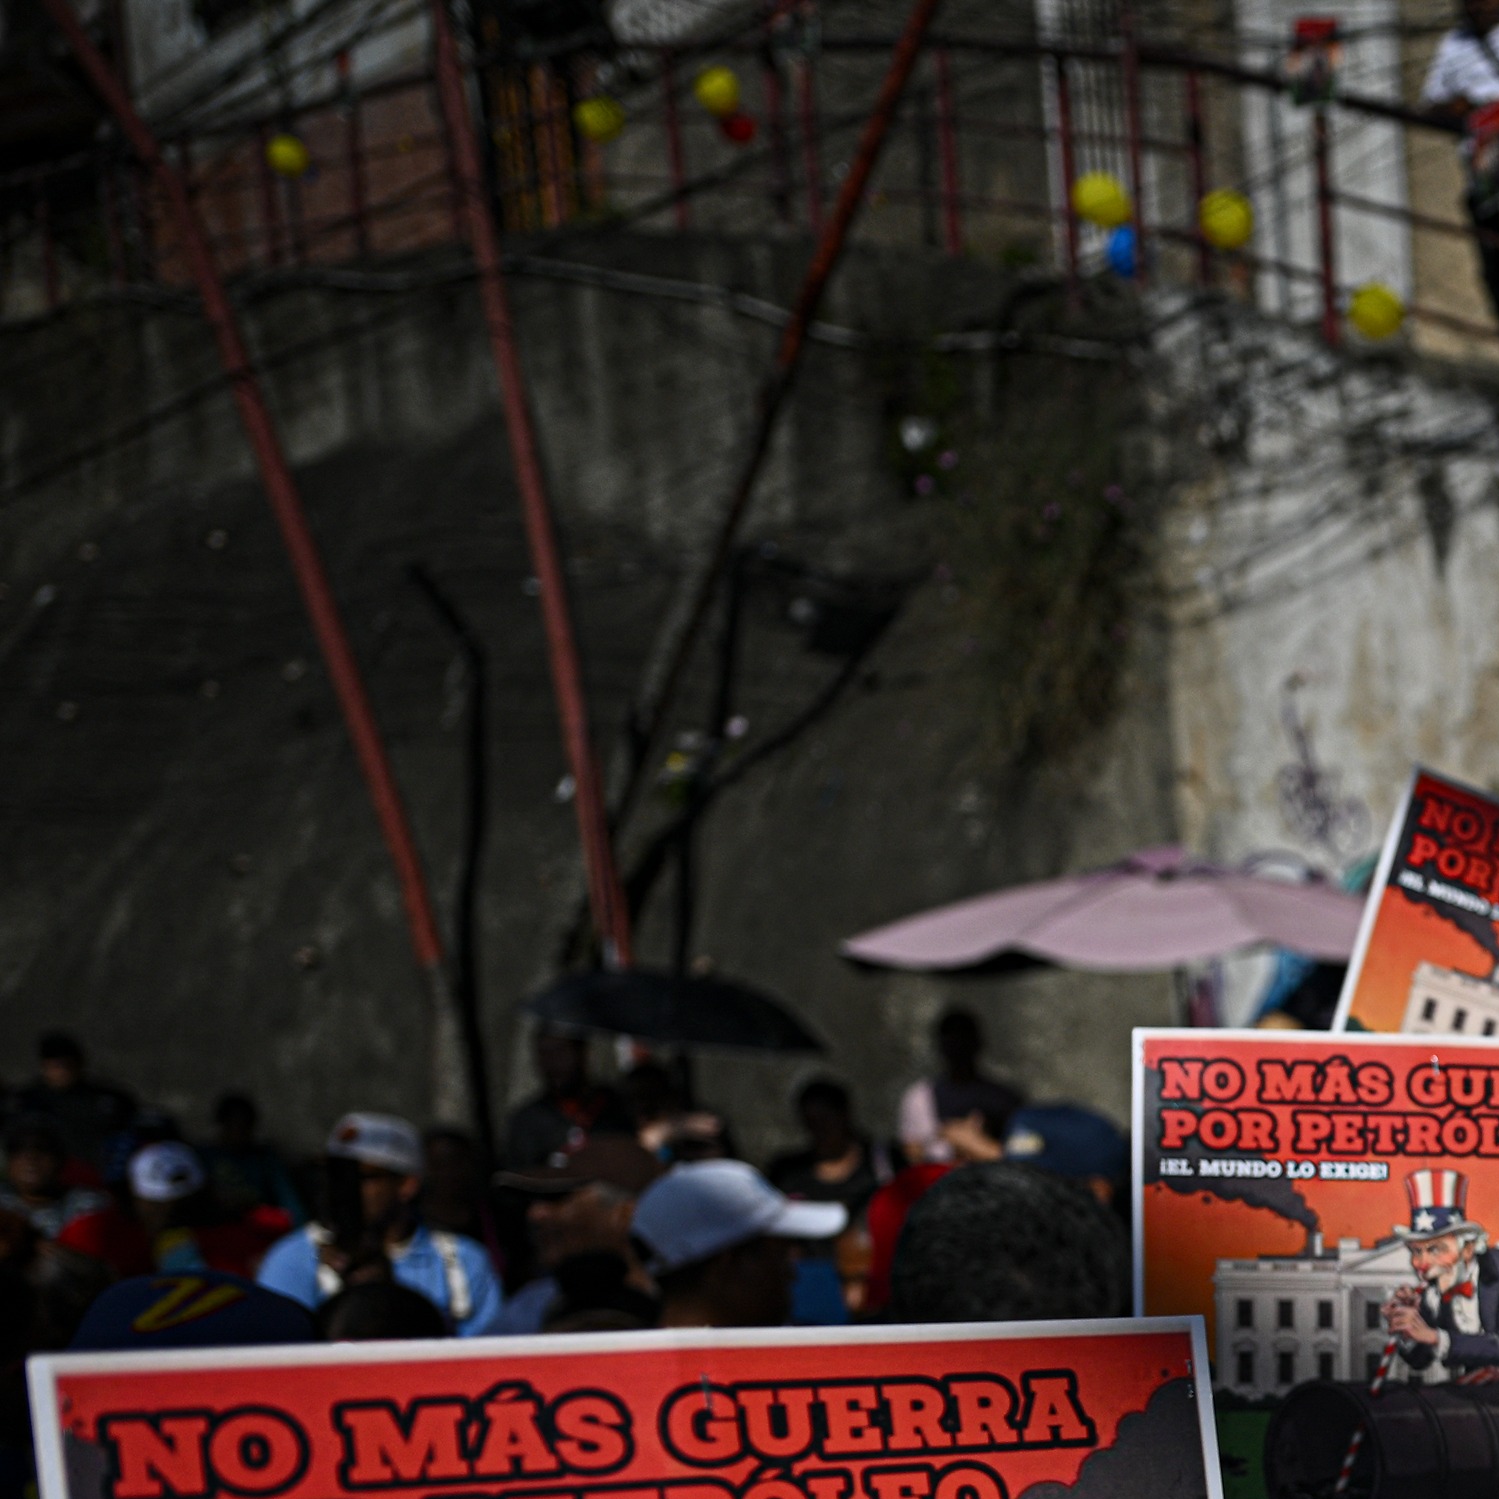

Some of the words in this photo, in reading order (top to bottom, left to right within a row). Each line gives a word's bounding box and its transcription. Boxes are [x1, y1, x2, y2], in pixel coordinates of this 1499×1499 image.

[1417, 794, 1485, 843] NO
[1405, 831, 1491, 891] POR
[1158, 1056, 1245, 1103] NO
[1257, 1056, 1395, 1106] MÁS
[1158, 1104, 1278, 1154] POR
[1199, 1159, 1283, 1179] MUNDO
[1286, 1160, 1316, 1179] LO
[101, 1405, 311, 1499] NO
[331, 1380, 635, 1491] MÁS
[658, 1369, 1098, 1468] GUERRA
